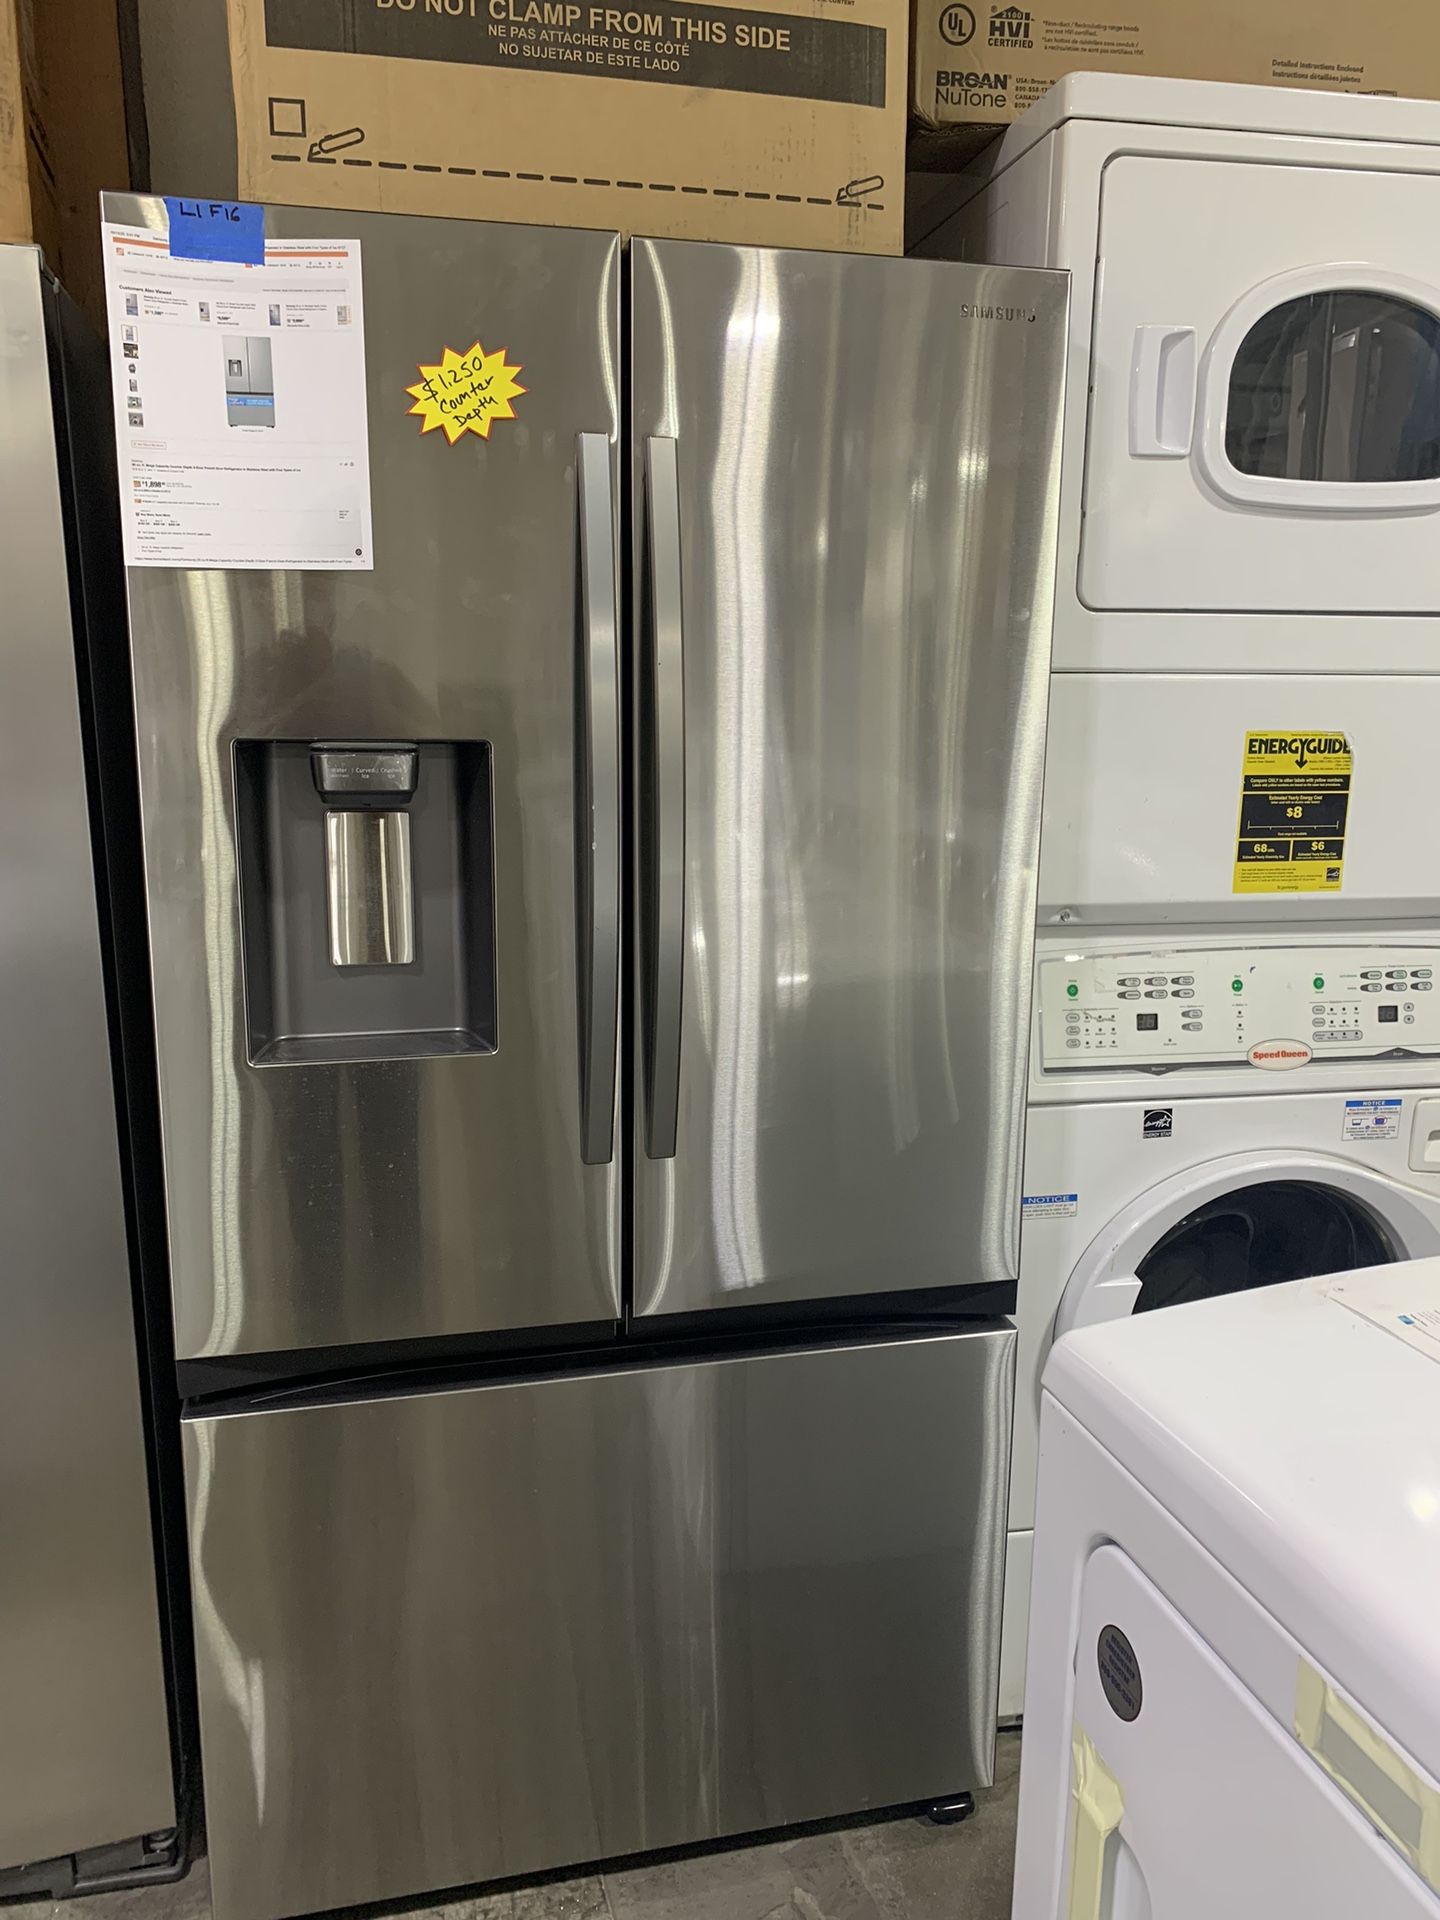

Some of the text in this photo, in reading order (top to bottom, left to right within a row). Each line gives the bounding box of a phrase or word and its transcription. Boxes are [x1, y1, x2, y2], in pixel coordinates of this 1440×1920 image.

[489, 0, 581, 27] CLAMP
[589, 8, 662, 36] FROM
[670, 16, 727, 44] THIS
[735, 24, 791, 51] SIDE
[948, 12, 966, 37] UL
[989, 20, 1030, 38] HVI
[488, 24, 690, 56] NE PAS ATTACHER DE CE CÔTÉ
[988, 38, 1033, 49] CERTIFIED
[499, 42, 680, 72] NO SUJETAR DE ESTE LADO
[1272, 59, 1298, 68] Detailed
[1337, 64, 1364, 73] Enclosed
[936, 70, 1008, 90] BROAN
[1272, 70, 1308, 80] Instructions
[936, 87, 1006, 108] NuTone
[209, 204, 240, 222] F16
[119, 284, 144, 292] Customers
[440, 376, 494, 414] Counter
[1286, 806, 1303, 818] $8
[1253, 844, 1268, 853] 68
[1311, 841, 1325, 851] $6
[1253, 1050, 1308, 1060] Speed Queen
